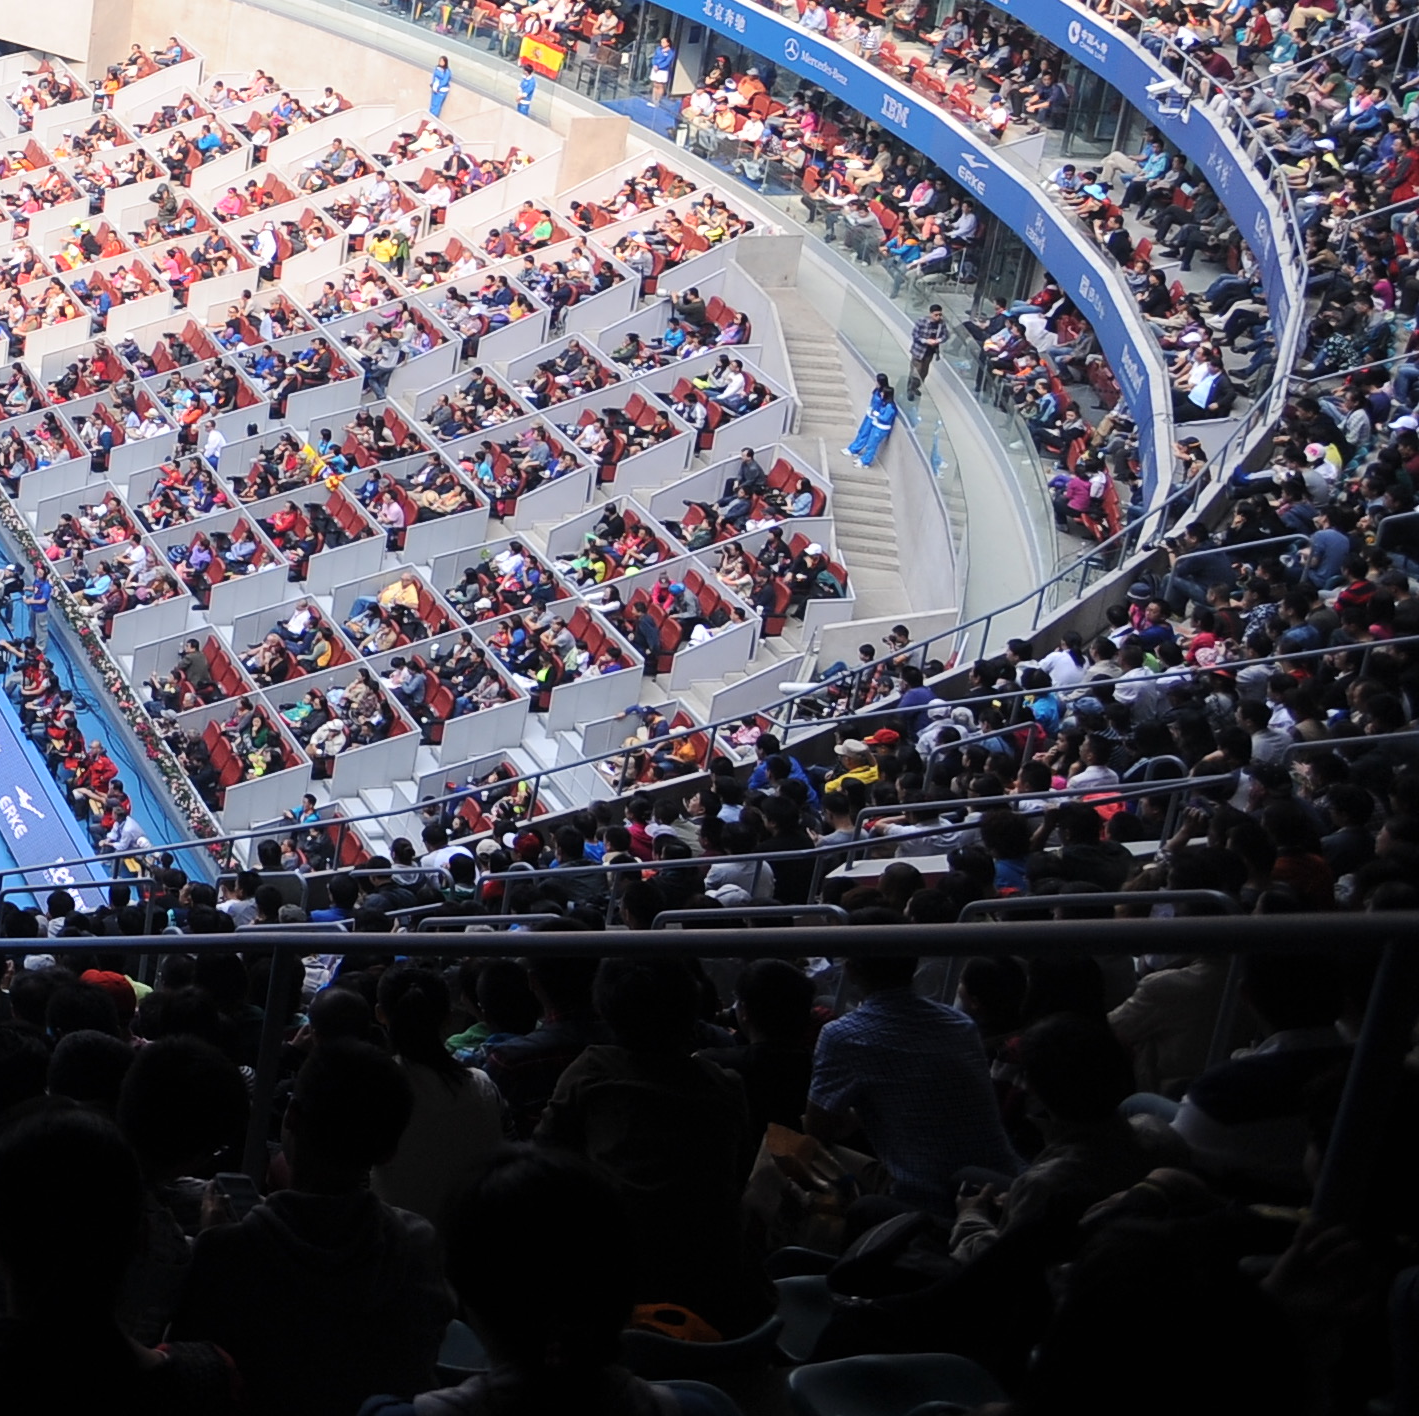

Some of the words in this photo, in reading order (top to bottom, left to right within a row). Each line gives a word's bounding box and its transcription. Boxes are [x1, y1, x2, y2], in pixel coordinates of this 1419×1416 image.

[881, 93, 910, 128] IBM
[957, 165, 986, 195] ERKE
[0, 795, 28, 840] ERKE
